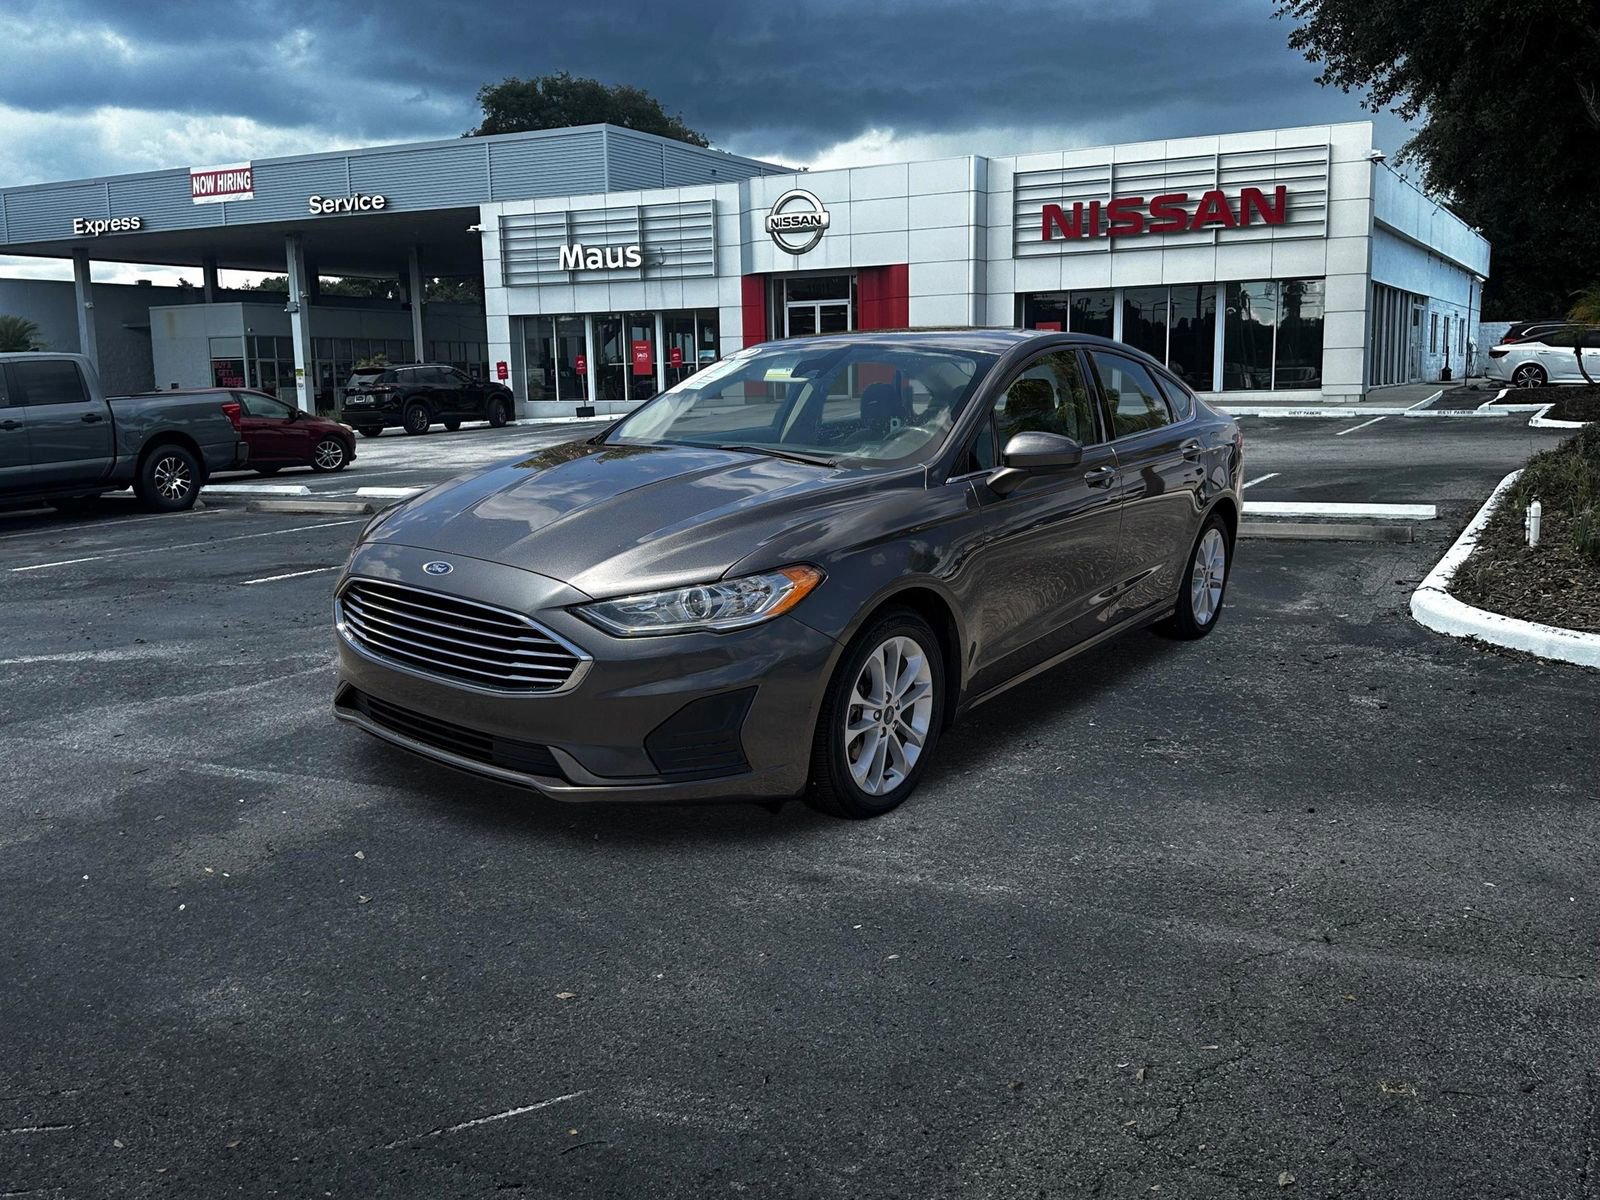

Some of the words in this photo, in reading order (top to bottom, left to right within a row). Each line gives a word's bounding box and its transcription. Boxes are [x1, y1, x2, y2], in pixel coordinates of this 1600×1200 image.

[192, 175, 215, 195] NOW
[217, 171, 251, 193] HIRING
[309, 193, 385, 215] Service
[1042, 185, 1287, 241] NISSAN
[73, 216, 141, 237] Express
[770, 214, 822, 228] NISSAN
[559, 243, 642, 271] Maus
[223, 377, 244, 387] FREE
[428, 563, 447, 573] Ford
